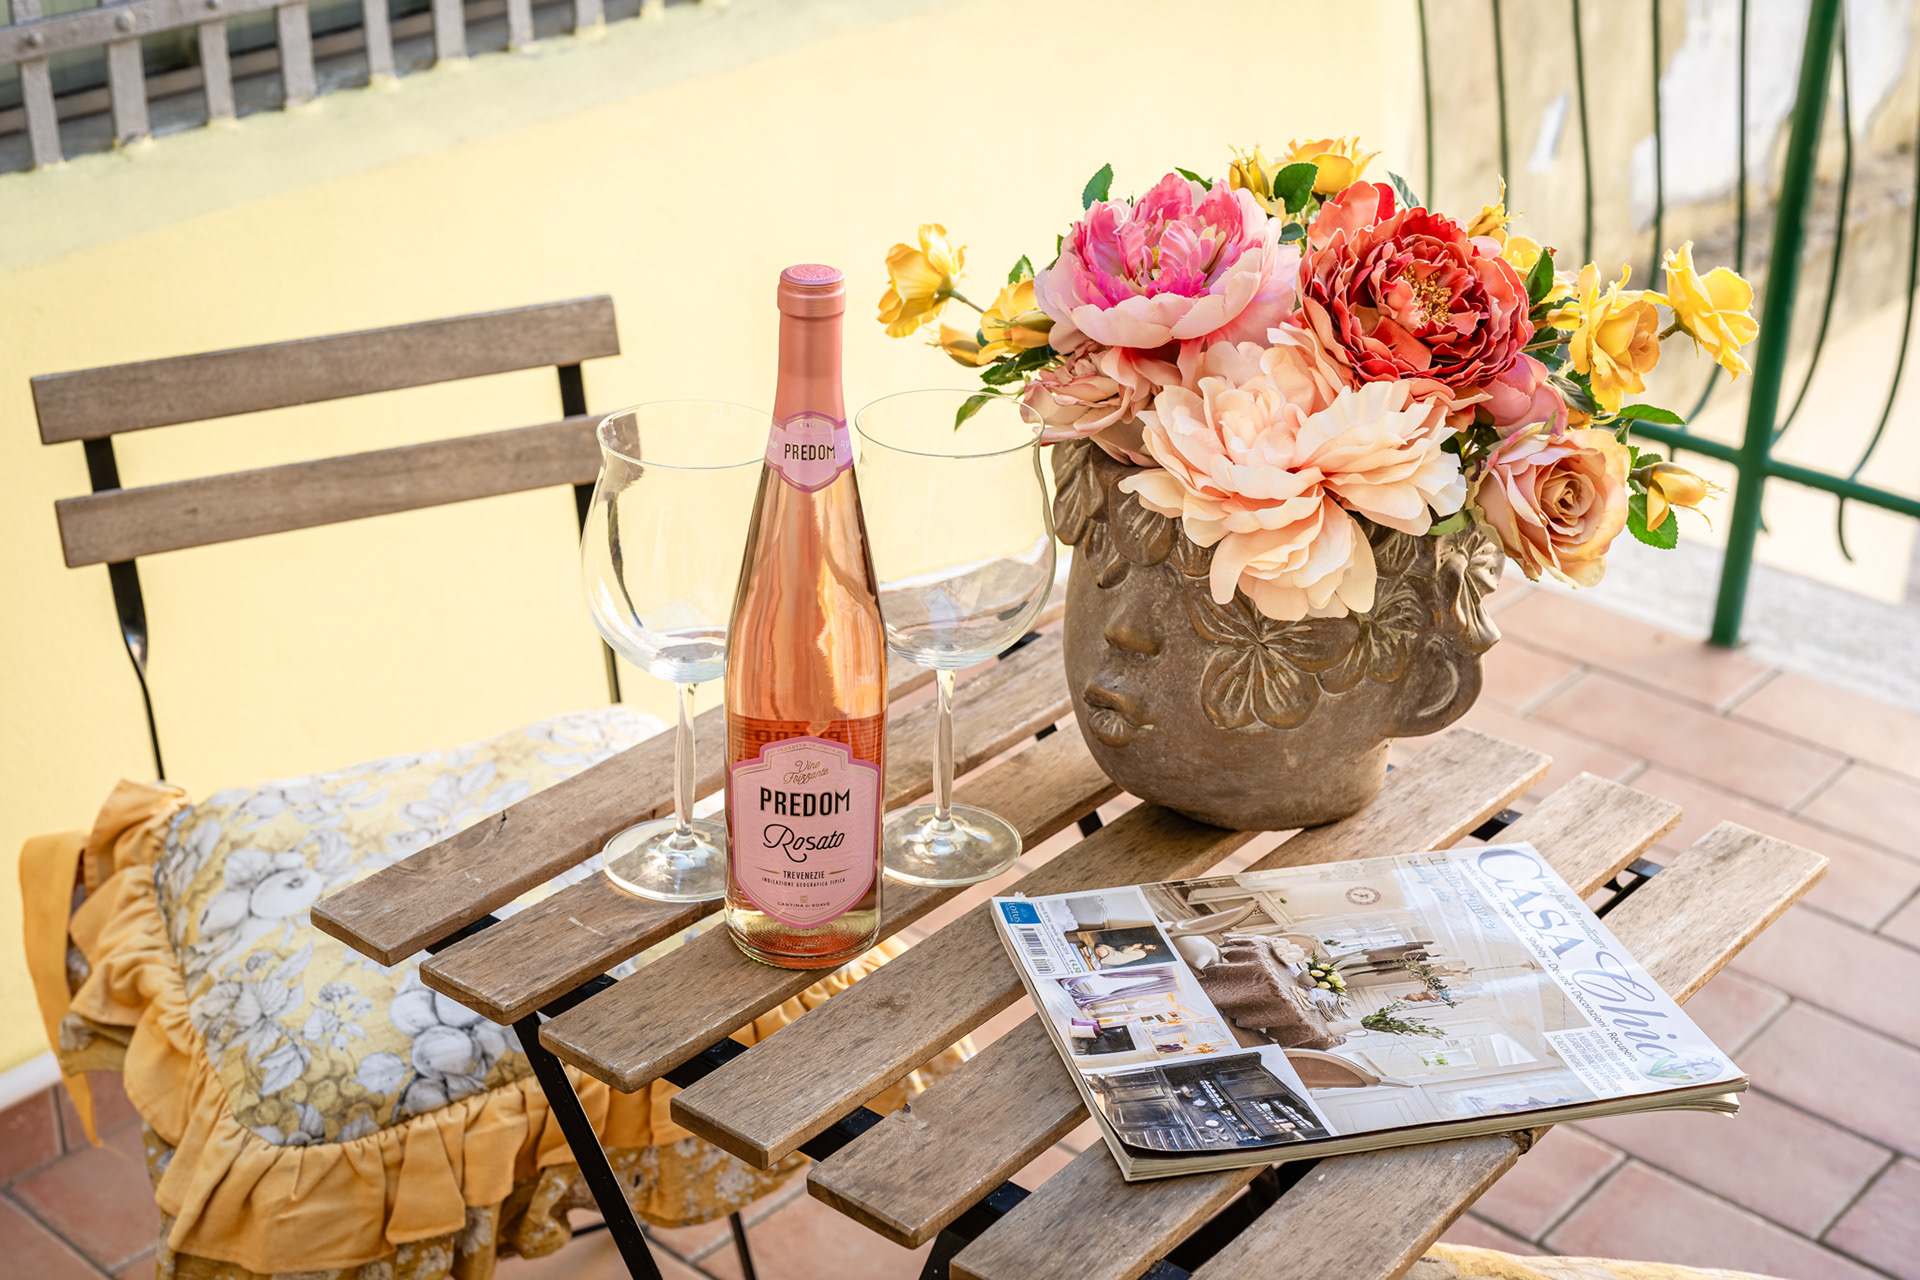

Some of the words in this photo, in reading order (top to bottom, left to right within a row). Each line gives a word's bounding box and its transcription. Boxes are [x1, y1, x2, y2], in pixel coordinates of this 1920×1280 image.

[784, 443, 836, 461] PREDOM
[795, 760, 821, 773] Vino
[783, 768, 829, 785] Frizzante
[760, 786, 851, 817] PREDOM
[763, 823, 845, 863] Rosato
[762, 877, 794, 887] INDICAZIONE
[783, 870, 825, 880] TREVENEZIE
[1008, 903, 1021, 923] LOTUS
[1477, 849, 1585, 960] CASA
[1572, 951, 1677, 1059] Chic
[1526, 936, 1549, 959] Shabby
[1572, 990, 1609, 1028] Decorazioni
[1608, 1032, 1638, 1063] Recupero
